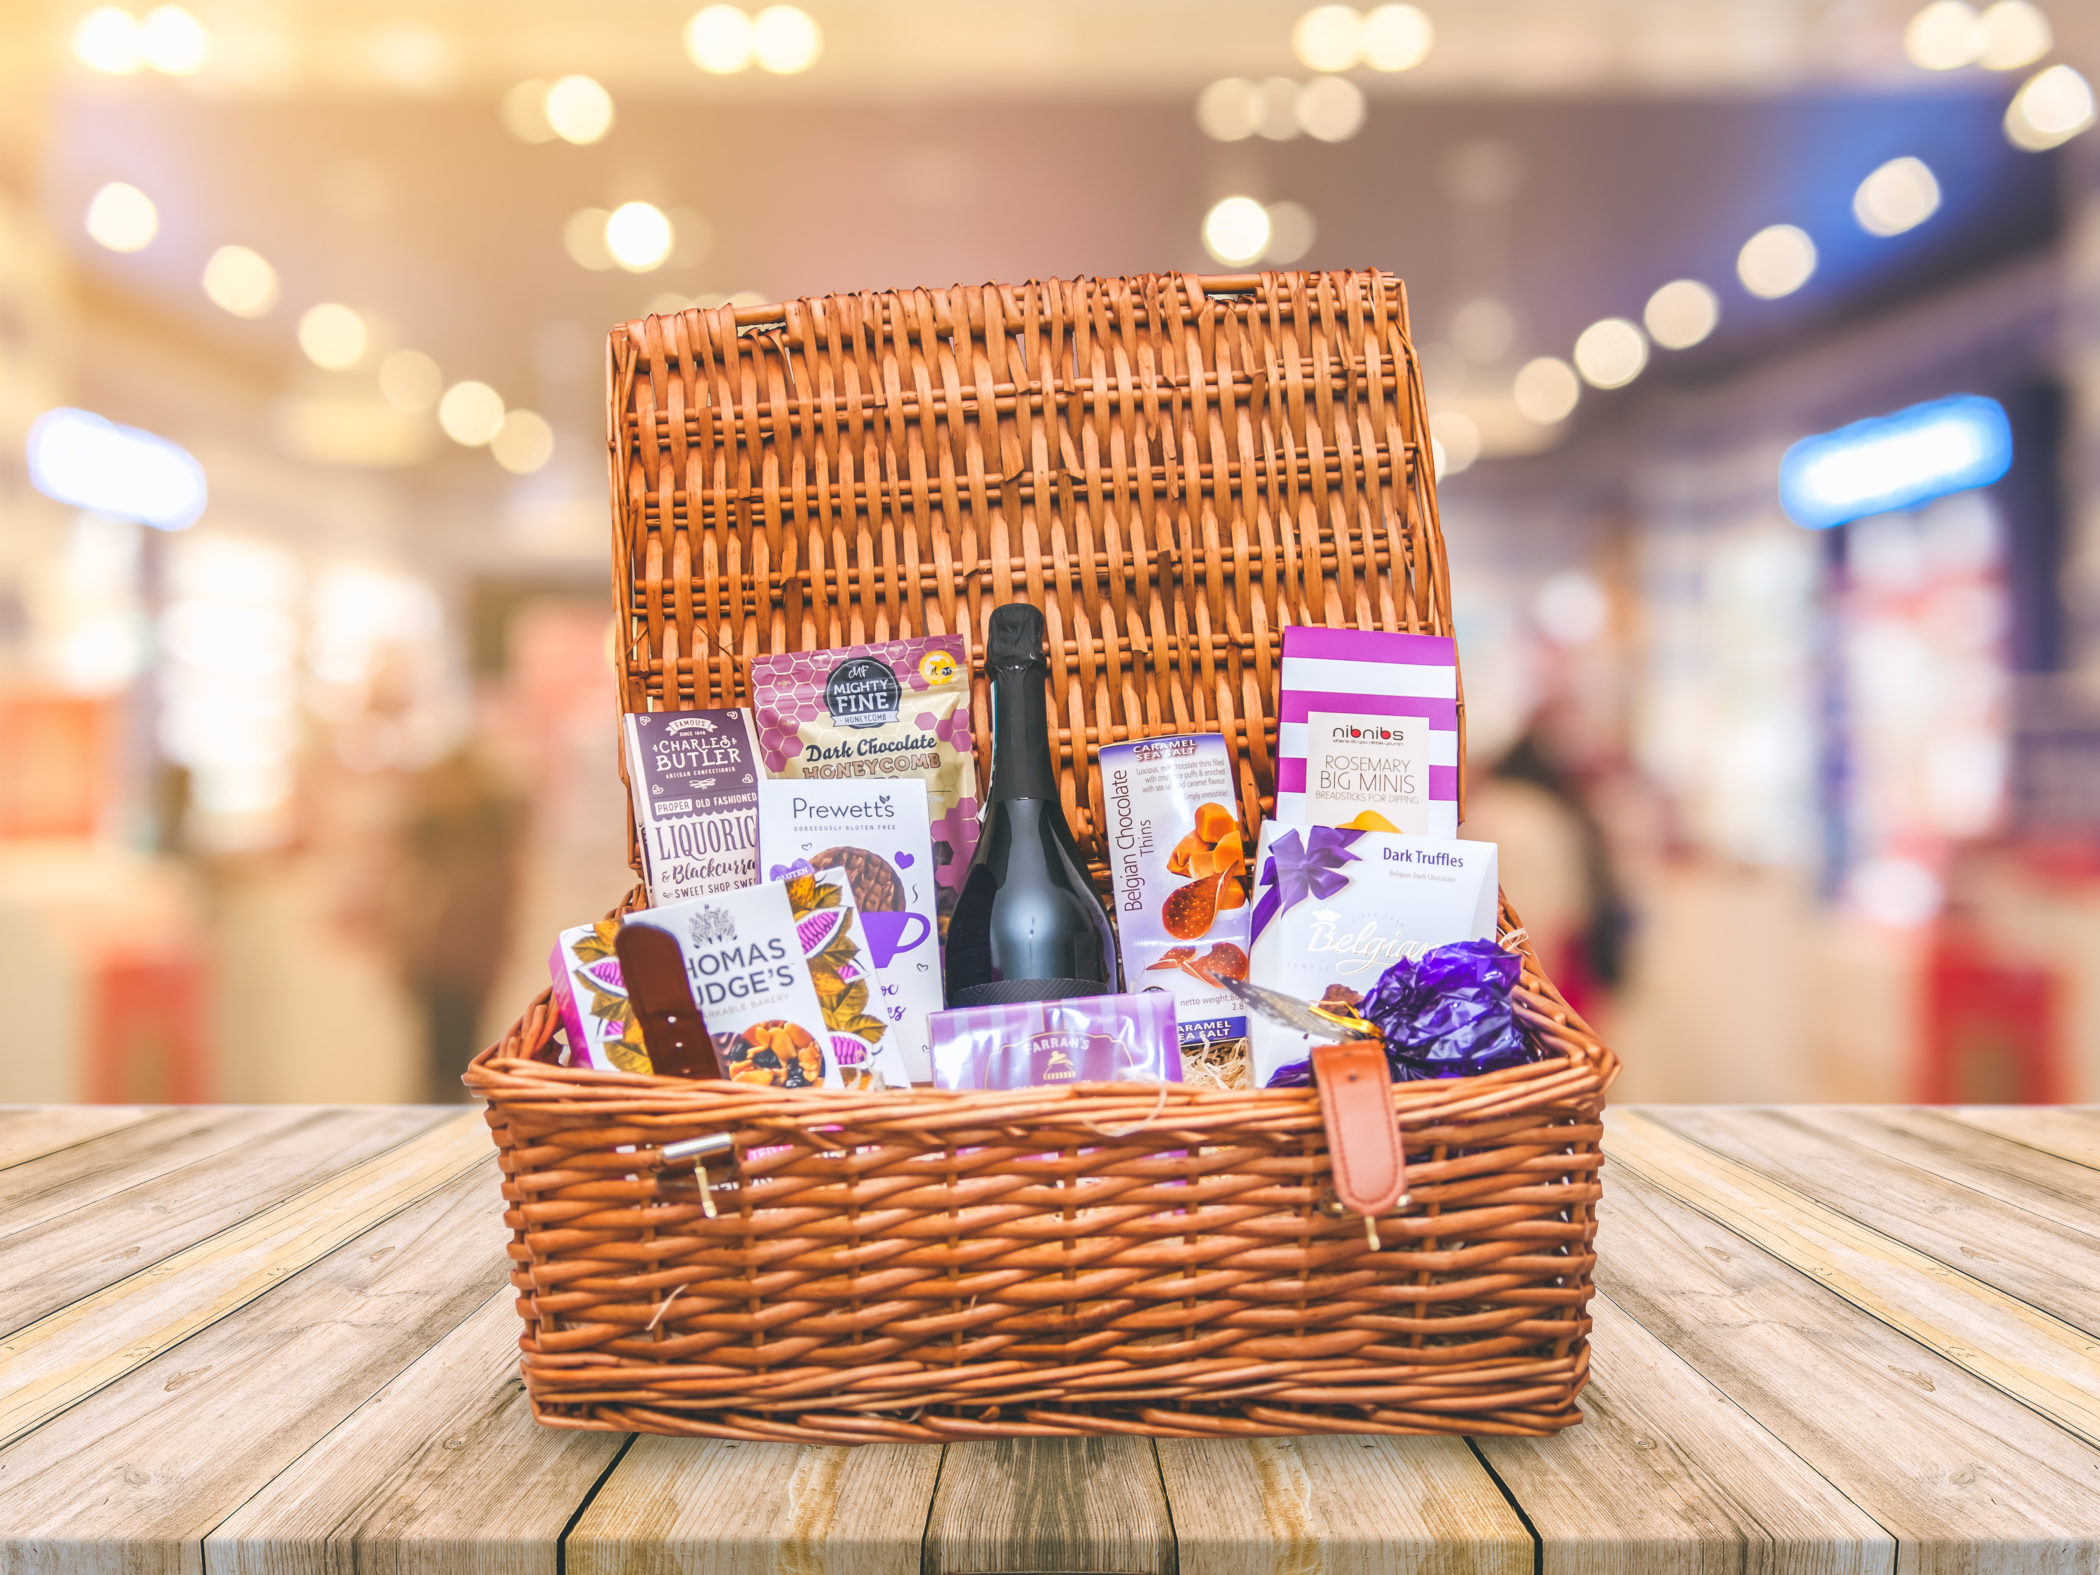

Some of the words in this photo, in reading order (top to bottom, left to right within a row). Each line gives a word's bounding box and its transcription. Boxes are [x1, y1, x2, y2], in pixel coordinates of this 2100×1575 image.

[833, 679, 889, 695] MIGHTY
[836, 692, 890, 713] FINE
[674, 719, 706, 728] FAMOUS
[844, 714, 887, 724] HONEYCOMB
[1332, 724, 1404, 741] nibnibs
[659, 735, 731, 754] CHARLES
[805, 740, 853, 762] Dark
[856, 734, 937, 756] Chocolate
[1133, 739, 1197, 753] CARAMEL
[656, 748, 742, 772] BUTLER
[803, 752, 942, 779] HONEYCOMB
[1136, 752, 1161, 761] SEA
[1174, 761, 1198, 769] hocolate
[1325, 755, 1411, 773] ROSEMARY
[666, 771, 691, 779] ARTISAN
[1320, 770, 1351, 790] BIG
[1359, 773, 1415, 794] MINIS
[657, 801, 690, 813] PROPER
[695, 798, 711, 808] OLD
[713, 792, 757, 806] FASHIONED
[1315, 790, 1366, 801] BREADSTICKS
[1368, 793, 1385, 802] FOR
[1388, 795, 1419, 804] DIPPING
[1111, 769, 1136, 850] Chocolate
[655, 815, 756, 861] LIQUORIC
[1138, 819, 1154, 857] Thins
[1383, 847, 1413, 863] Dark
[1415, 850, 1464, 868] Truffles
[672, 858, 756, 885] Blackcurra
[674, 885, 705, 899] SWEET
[708, 882, 731, 894] SHOP
[1120, 854, 1146, 912] Belgian
[686, 938, 786, 979] HOMAS
[696, 965, 795, 1006] DGE'S
[750, 994, 789, 1009] BAKERY
[1180, 998, 1201, 1007] netto
[1178, 1020, 1232, 1033] ARAMEL
[1024, 1037, 1090, 1056] FARRAH'S
[1178, 1033, 1196, 1041] EA
